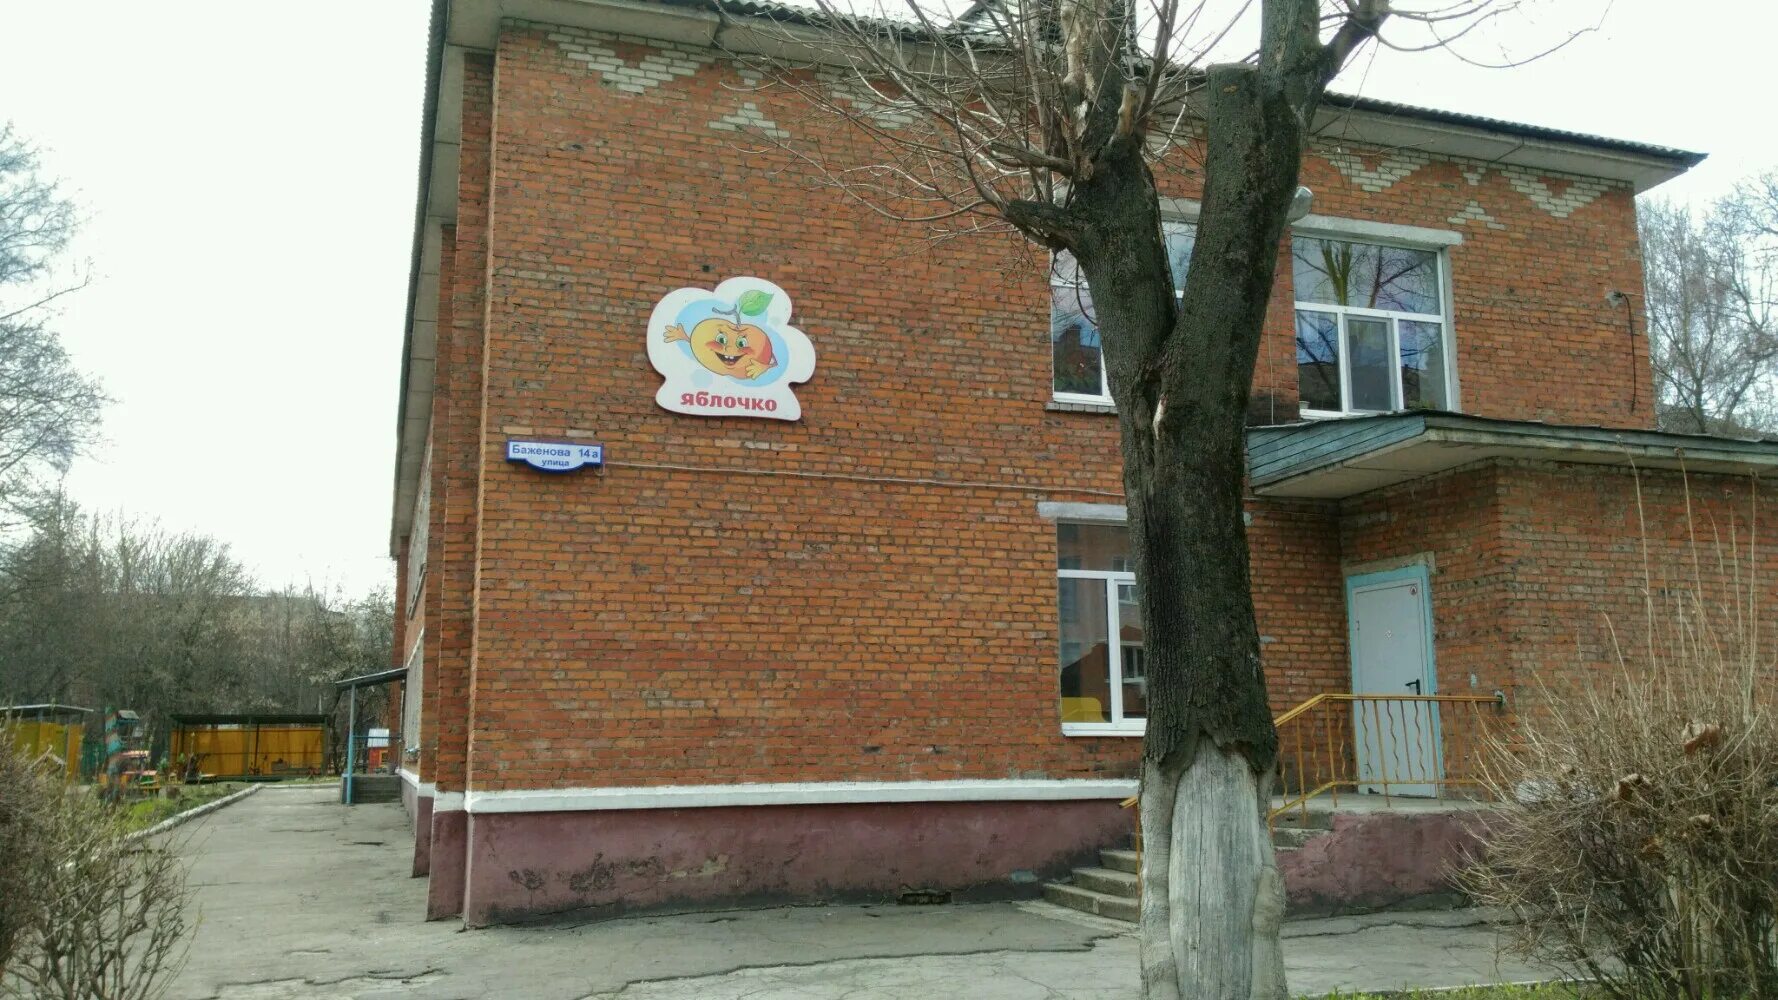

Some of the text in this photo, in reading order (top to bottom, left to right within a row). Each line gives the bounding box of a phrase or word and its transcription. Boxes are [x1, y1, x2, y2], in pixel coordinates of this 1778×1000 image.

[680, 391, 778, 412] яблочко
[512, 444, 571, 457] Баженова
[541, 459, 570, 467] улица
